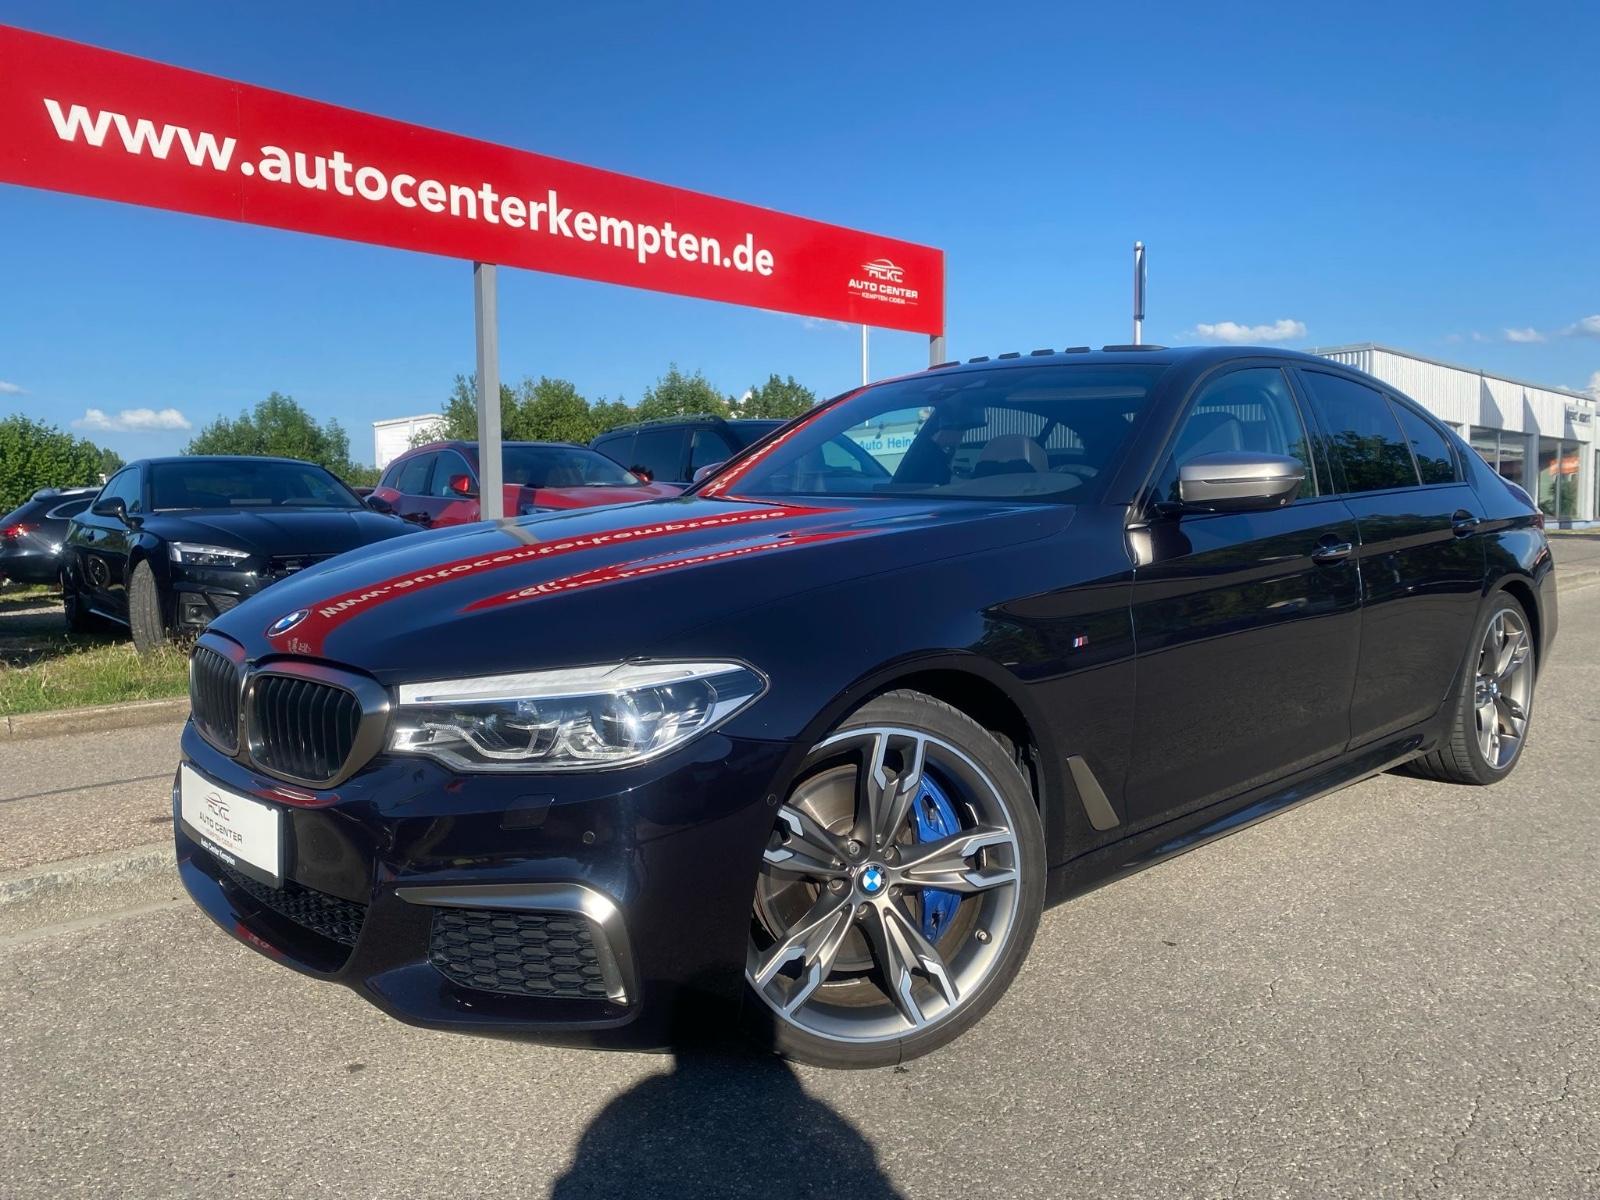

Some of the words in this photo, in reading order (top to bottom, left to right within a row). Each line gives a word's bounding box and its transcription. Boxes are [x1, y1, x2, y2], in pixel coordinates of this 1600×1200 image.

[43, 97, 774, 276] www.autocenterkempten.de
[848, 278, 877, 291] AUTO
[879, 284, 918, 299] CENTER
[861, 292, 888, 302] KEMPTEN
[860, 439, 882, 450] Auto
[199, 812, 214, 828] AUTO
[215, 823, 243, 843] CENTER
